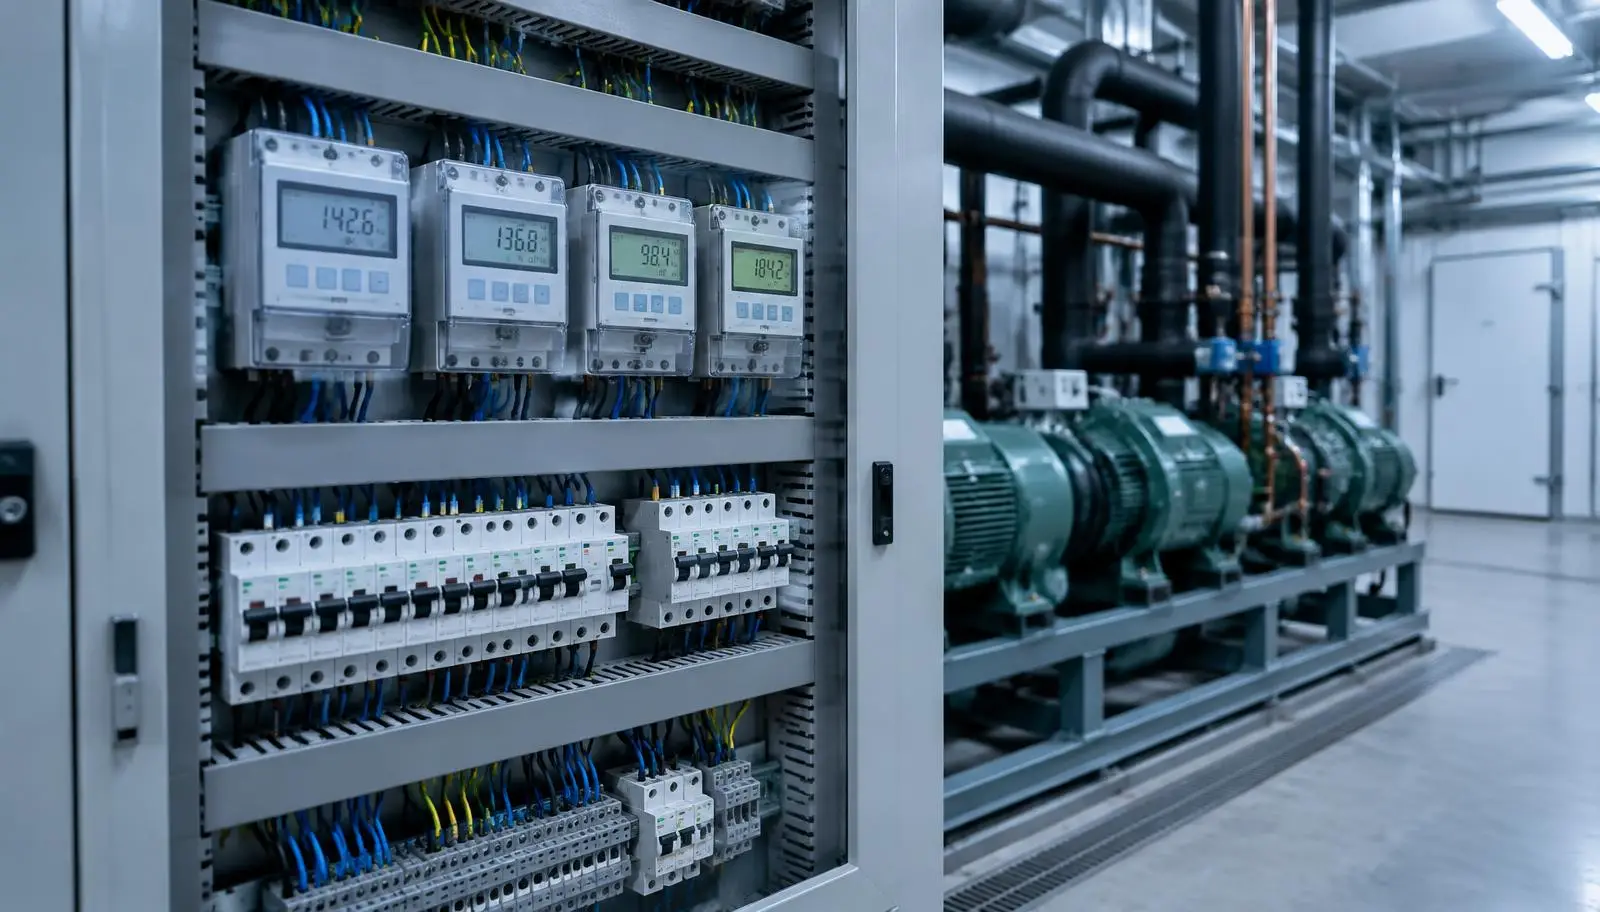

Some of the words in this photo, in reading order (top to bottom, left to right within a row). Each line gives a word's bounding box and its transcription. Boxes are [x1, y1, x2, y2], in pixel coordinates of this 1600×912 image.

[323, 205, 373, 236] 142.6
[496, 227, 538, 253] 136.8
[641, 244, 670, 268] 98.4
